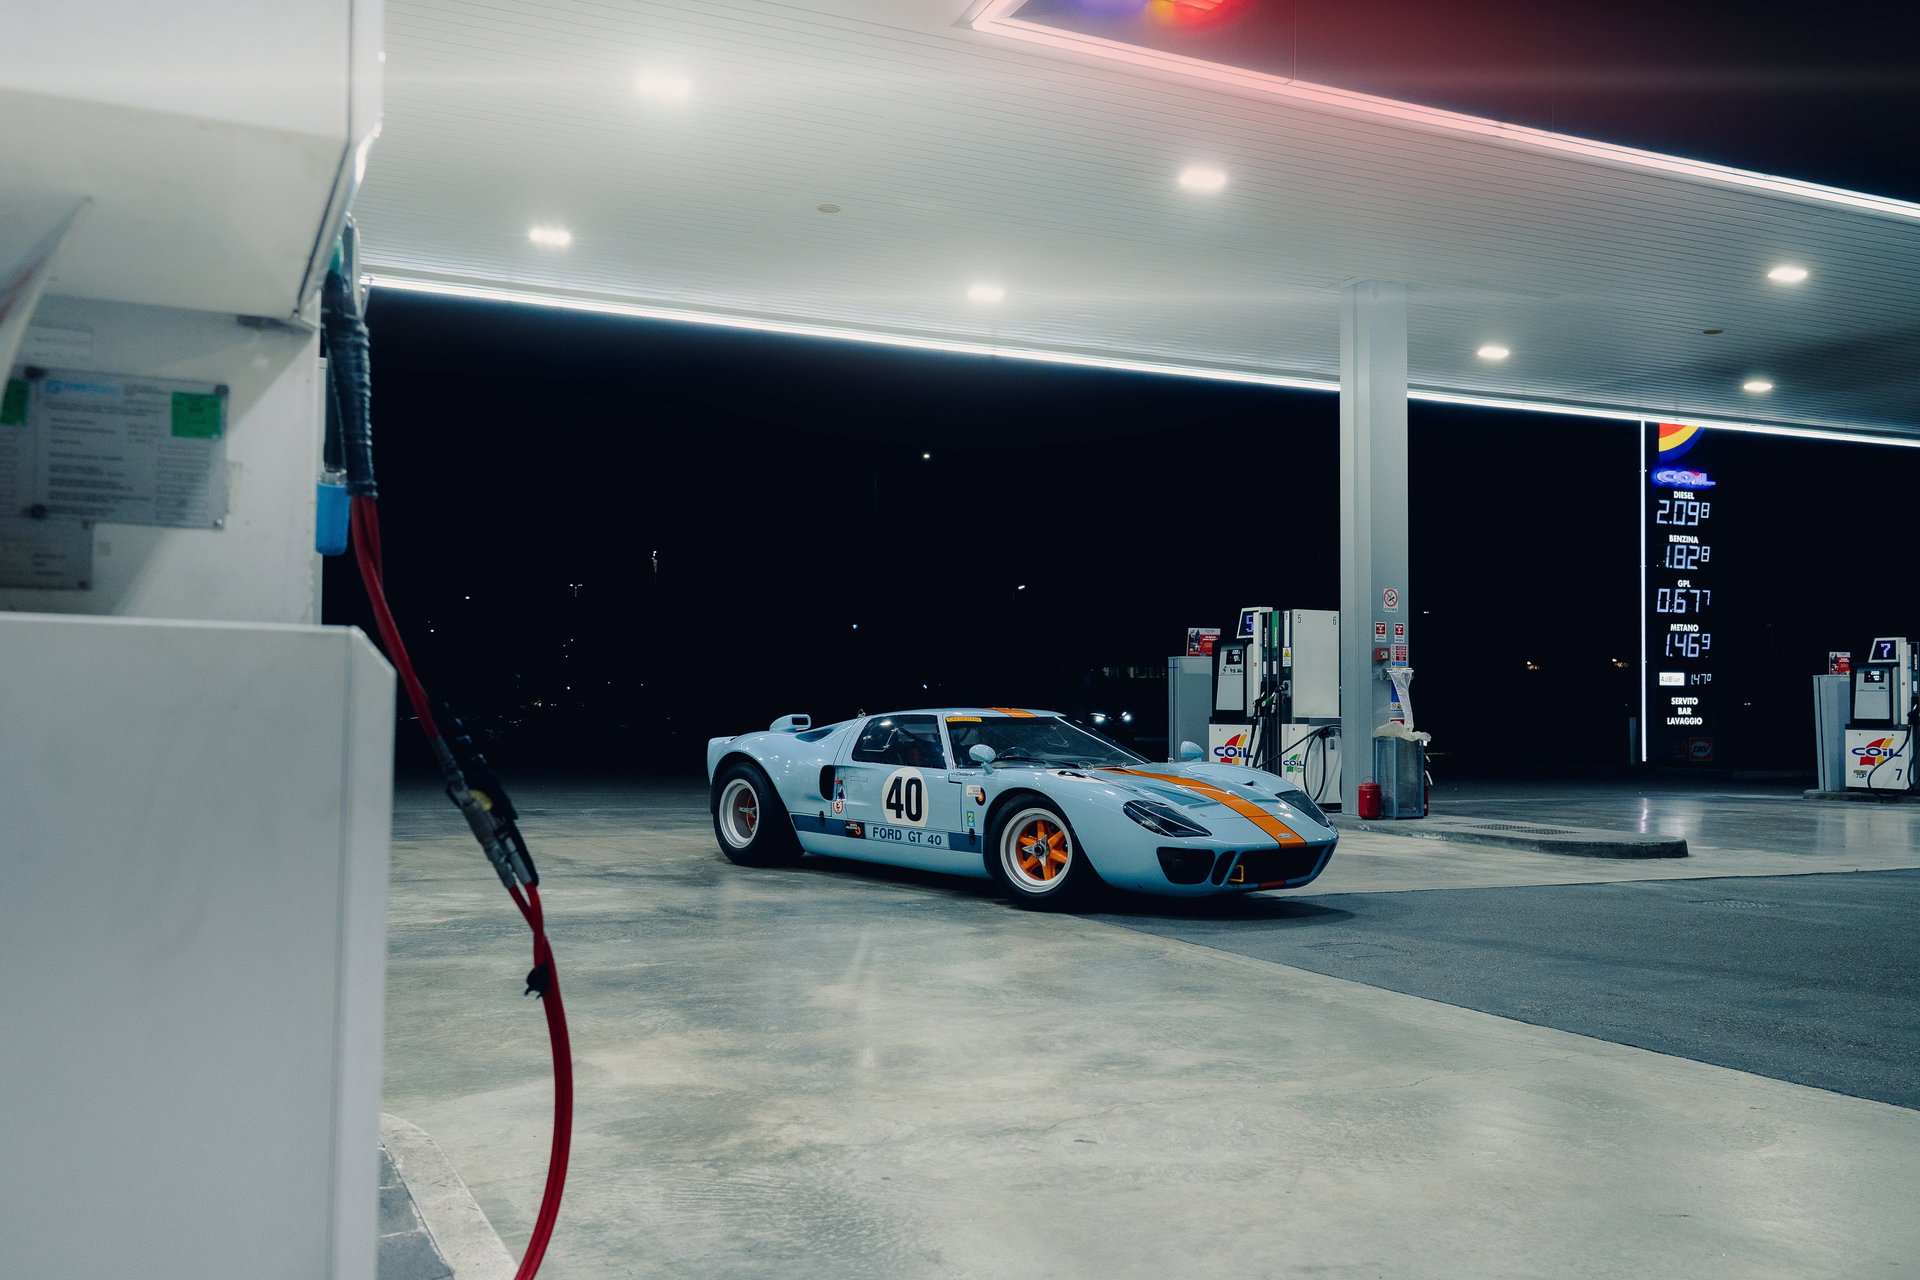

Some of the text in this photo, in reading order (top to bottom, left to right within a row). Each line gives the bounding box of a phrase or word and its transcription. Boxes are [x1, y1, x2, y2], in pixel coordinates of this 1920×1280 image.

[1673, 491, 1695, 499] DIESEL
[1669, 534, 1699, 544] BENZINA
[1677, 579, 1691, 588] GPL
[1245, 614, 1254, 633] 5
[1297, 613, 1302, 624] 5
[1332, 615, 1337, 626] 6
[1670, 624, 1699, 632] METANO
[1880, 642, 1891, 658] 7
[1671, 697, 1699, 705] SERVITO
[1677, 707, 1692, 715] BAR
[1667, 717, 1703, 725] LAVAGGIO
[1895, 768, 1903, 781] 7
[886, 775, 923, 822] 40
[872, 826, 942, 846] FORD GT 40
